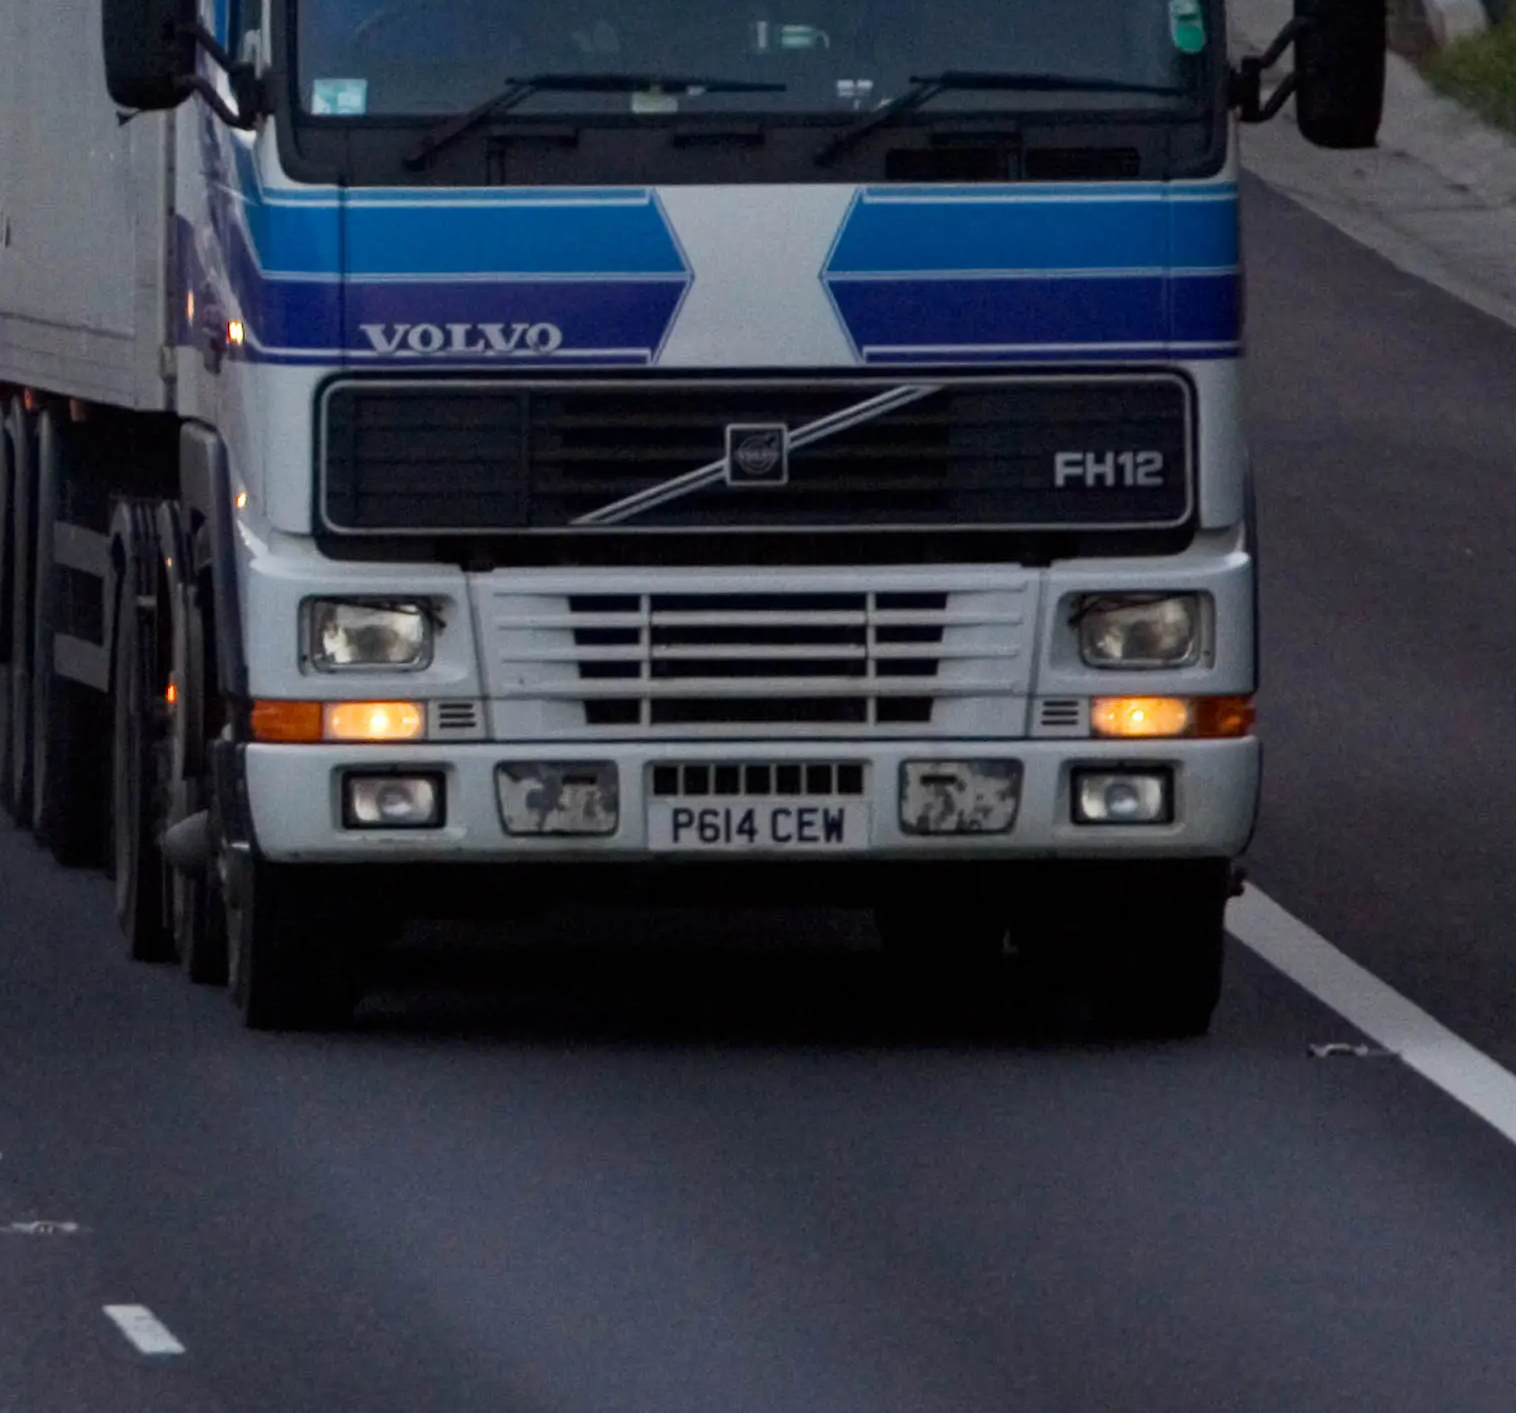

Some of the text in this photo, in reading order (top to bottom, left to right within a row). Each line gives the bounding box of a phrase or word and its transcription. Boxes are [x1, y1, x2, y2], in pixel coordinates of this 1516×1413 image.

[358, 322, 564, 356] VOLVO
[1054, 451, 1165, 487] FH12
[671, 807, 846, 844] P614 CEW
